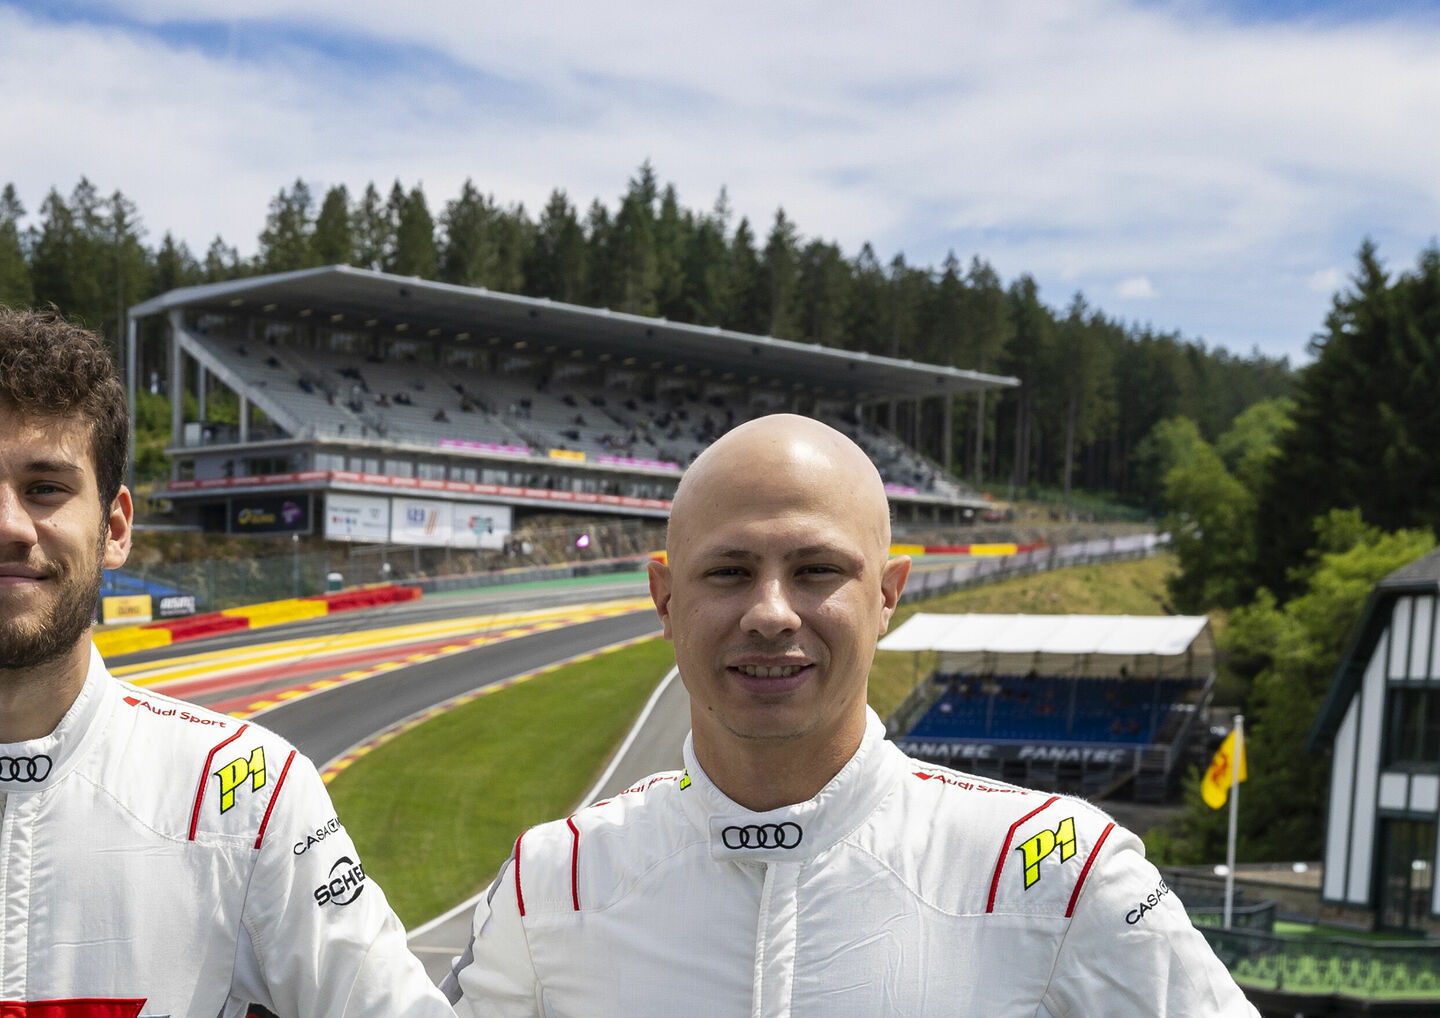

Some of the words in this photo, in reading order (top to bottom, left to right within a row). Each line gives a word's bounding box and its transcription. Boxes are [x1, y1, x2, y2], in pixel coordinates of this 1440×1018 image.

[140, 701, 176, 717] Audi
[180, 711, 227, 728] Sport
[1018, 745, 1126, 763] FANATEC
[213, 745, 267, 815] P1
[932, 774, 974, 791] Audi
[976, 784, 1029, 795] Sport
[1015, 817, 1077, 890] P1
